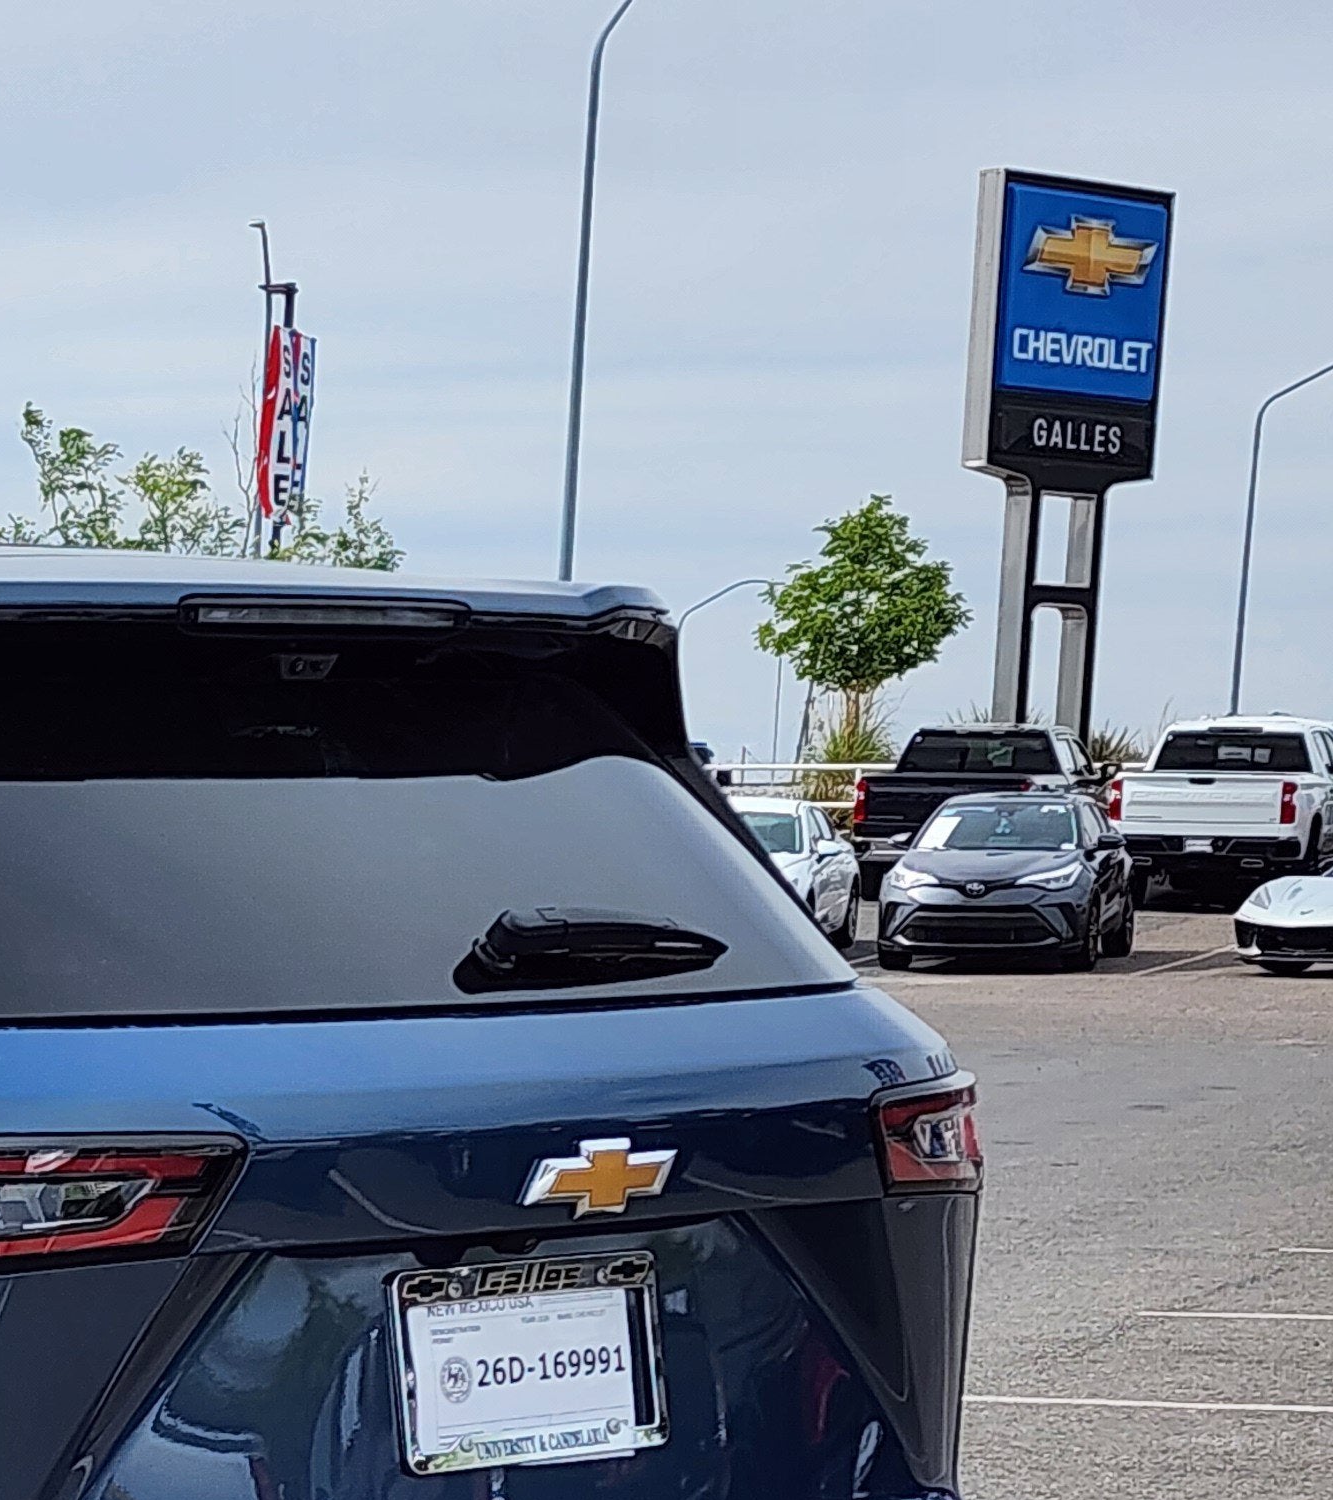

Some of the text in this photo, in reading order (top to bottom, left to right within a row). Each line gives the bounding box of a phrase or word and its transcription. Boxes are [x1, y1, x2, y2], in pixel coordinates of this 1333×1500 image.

[1012, 327, 1153, 374] CHEVROLET
[272, 343, 293, 507] SALE
[1032, 417, 1123, 455] GALLES
[474, 1260, 583, 1298] Galles
[476, 1344, 627, 1388] 26D-169991
